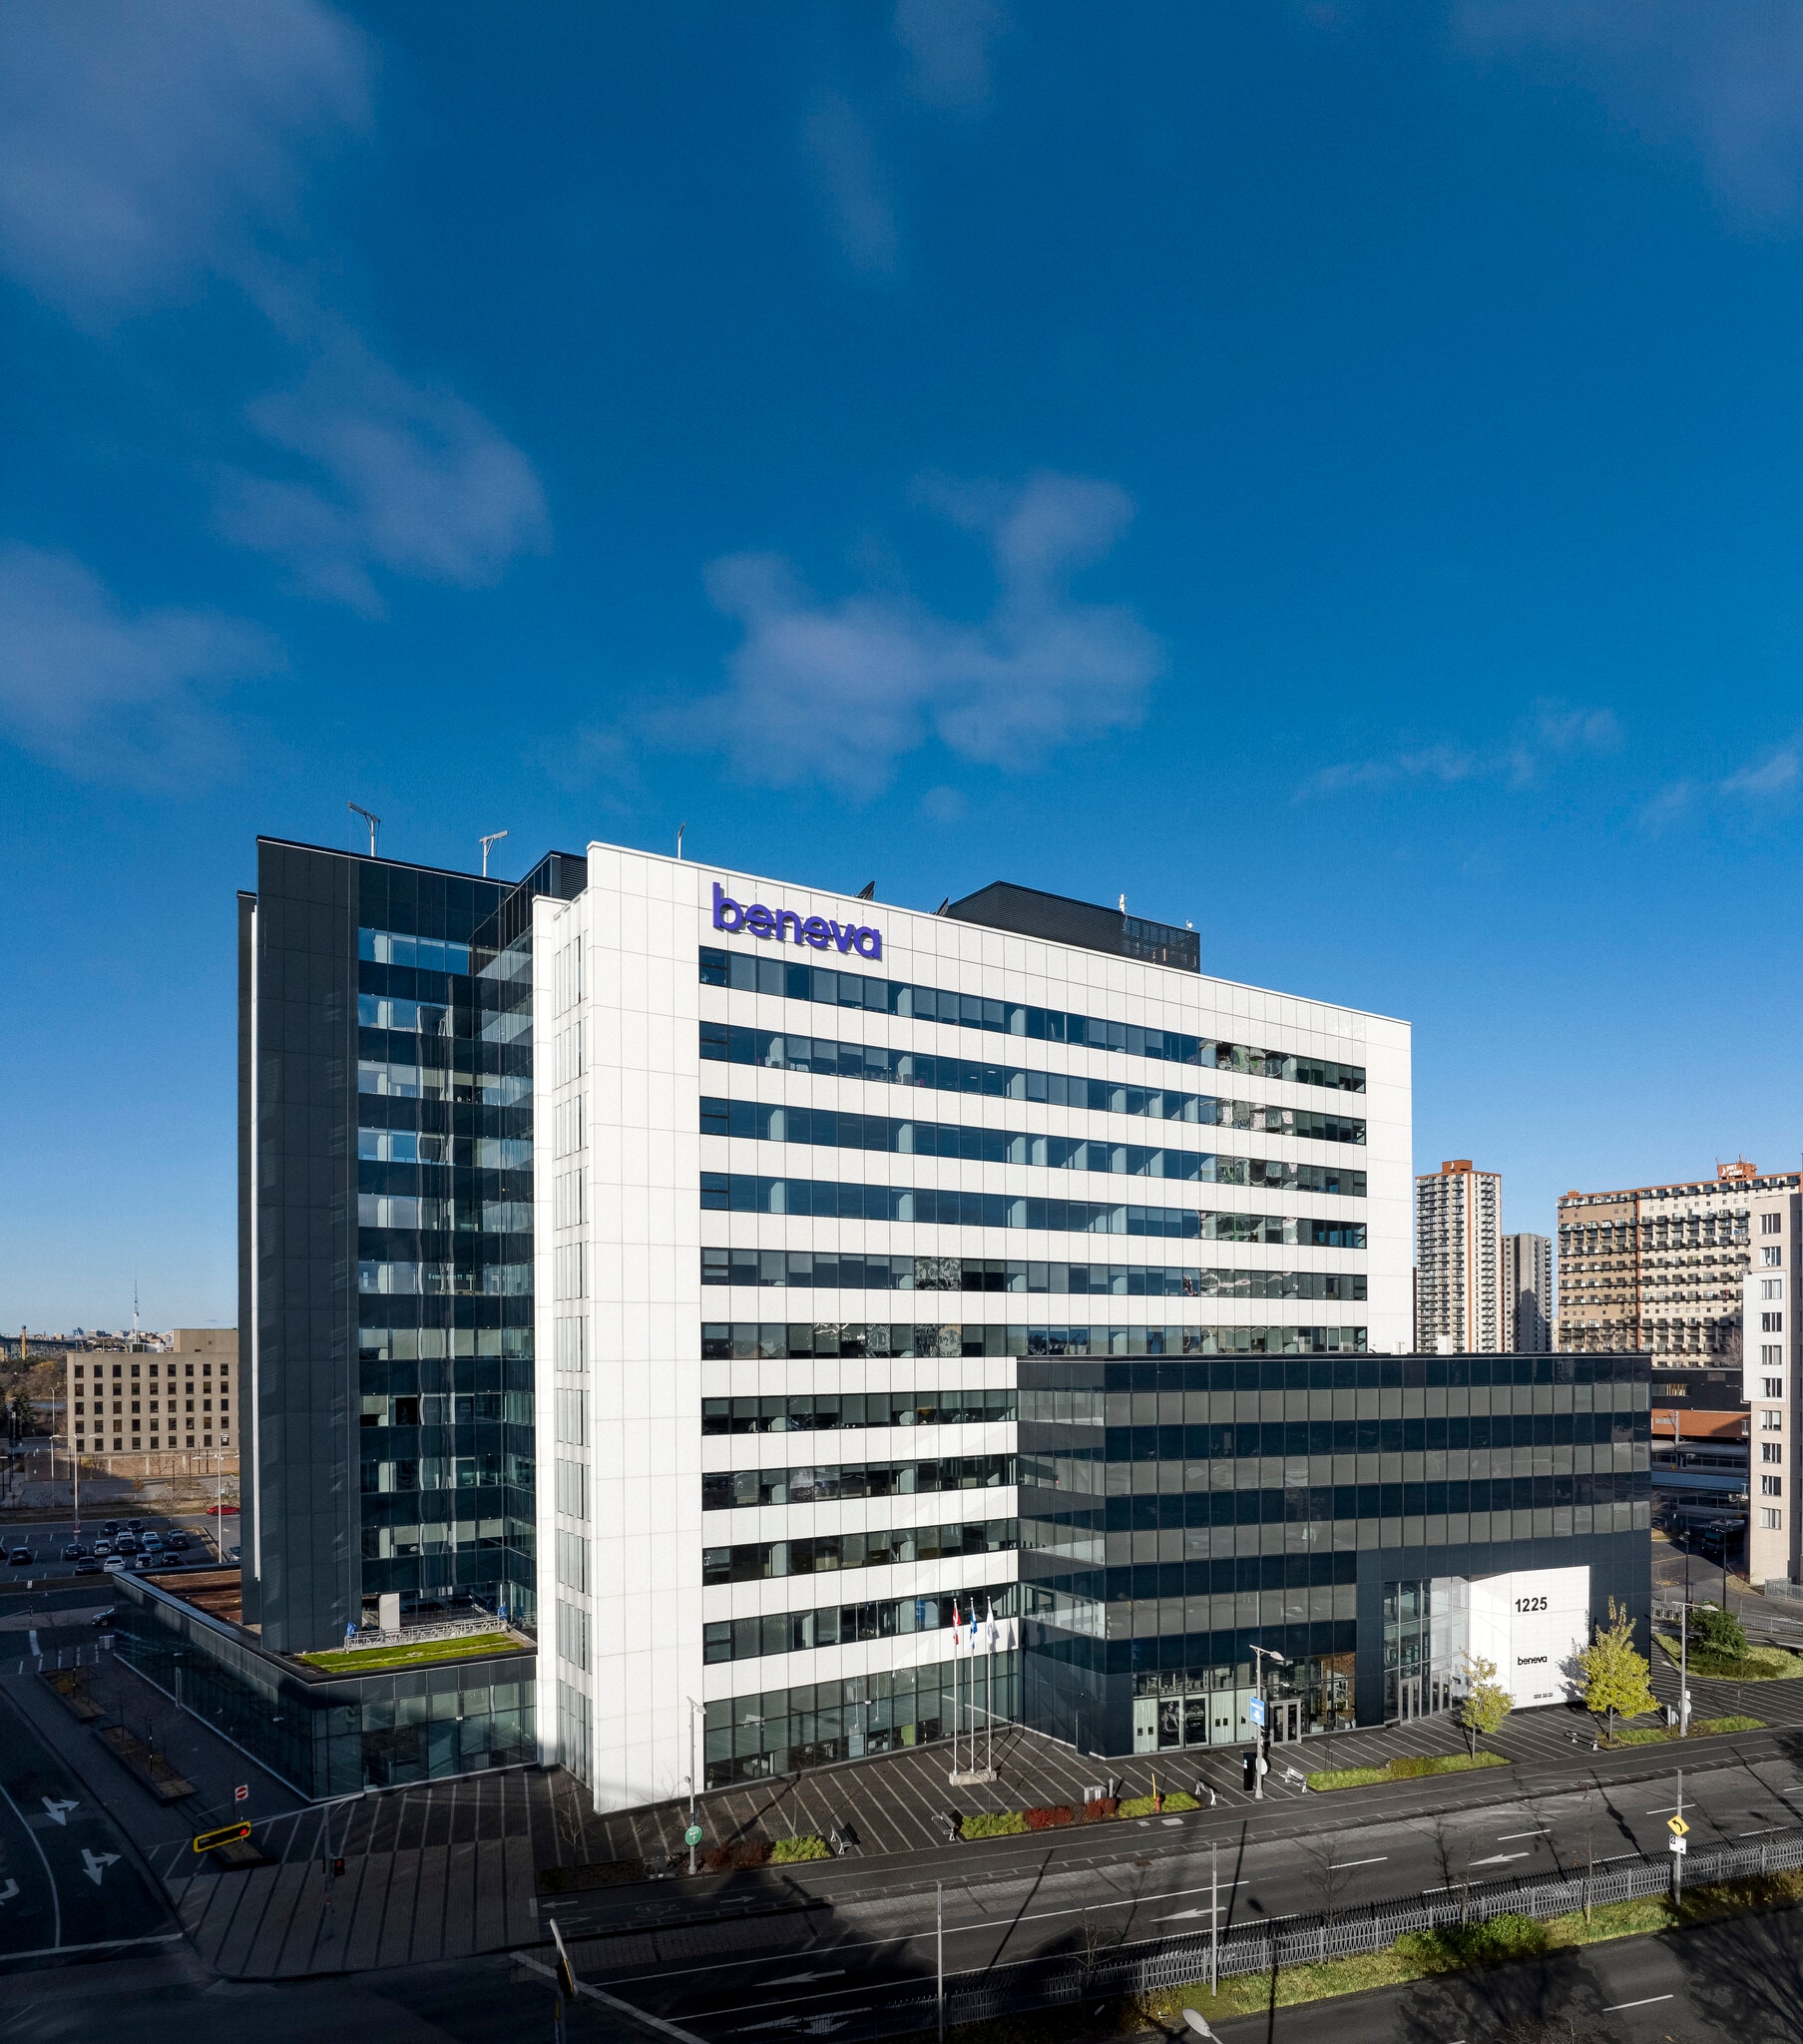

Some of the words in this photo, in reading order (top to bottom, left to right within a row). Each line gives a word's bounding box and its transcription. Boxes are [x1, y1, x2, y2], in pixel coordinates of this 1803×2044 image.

[712, 881, 881, 960] beneva
[1515, 1597, 1548, 1613] 1225
[1517, 1656, 1548, 1666] beneva
